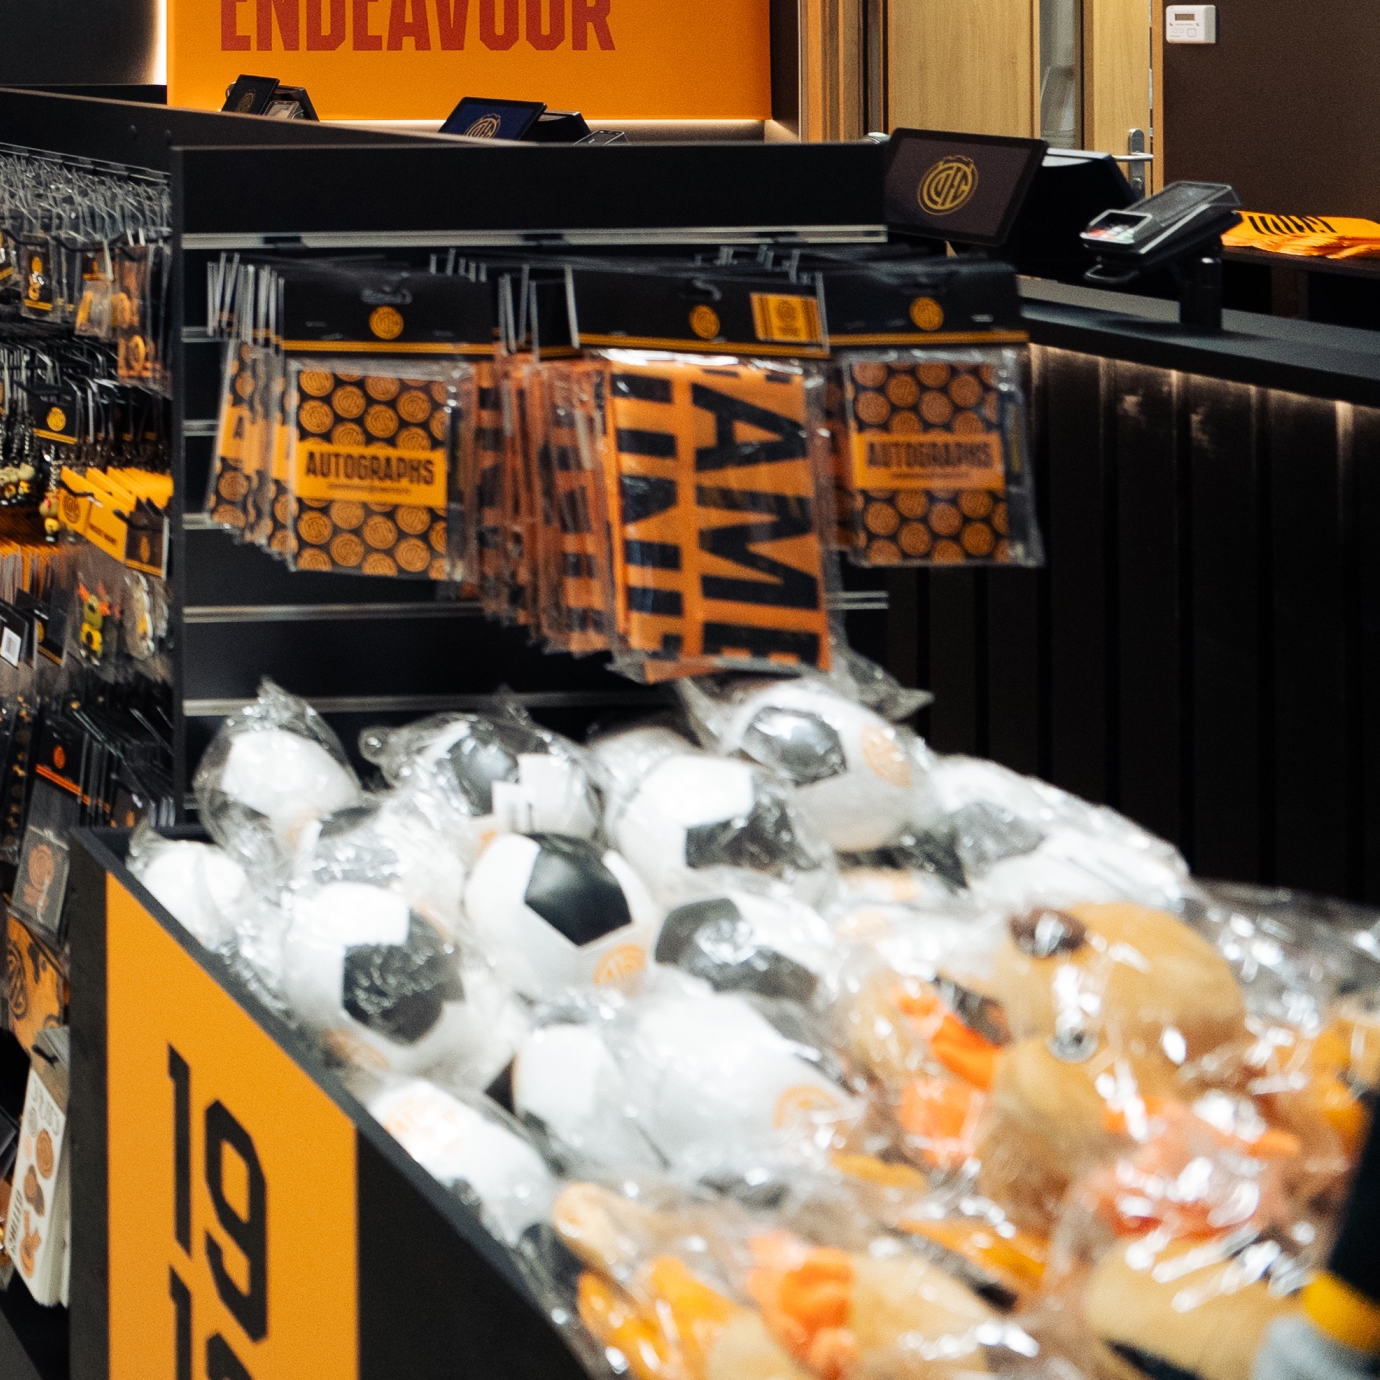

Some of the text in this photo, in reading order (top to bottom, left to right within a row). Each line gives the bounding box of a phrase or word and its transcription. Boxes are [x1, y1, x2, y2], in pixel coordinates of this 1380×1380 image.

[306, 451, 434, 485] AUTOGRAPHS
[867, 441, 991, 468] AUTOGRAPHS
[167, 1041, 270, 1343] 19
